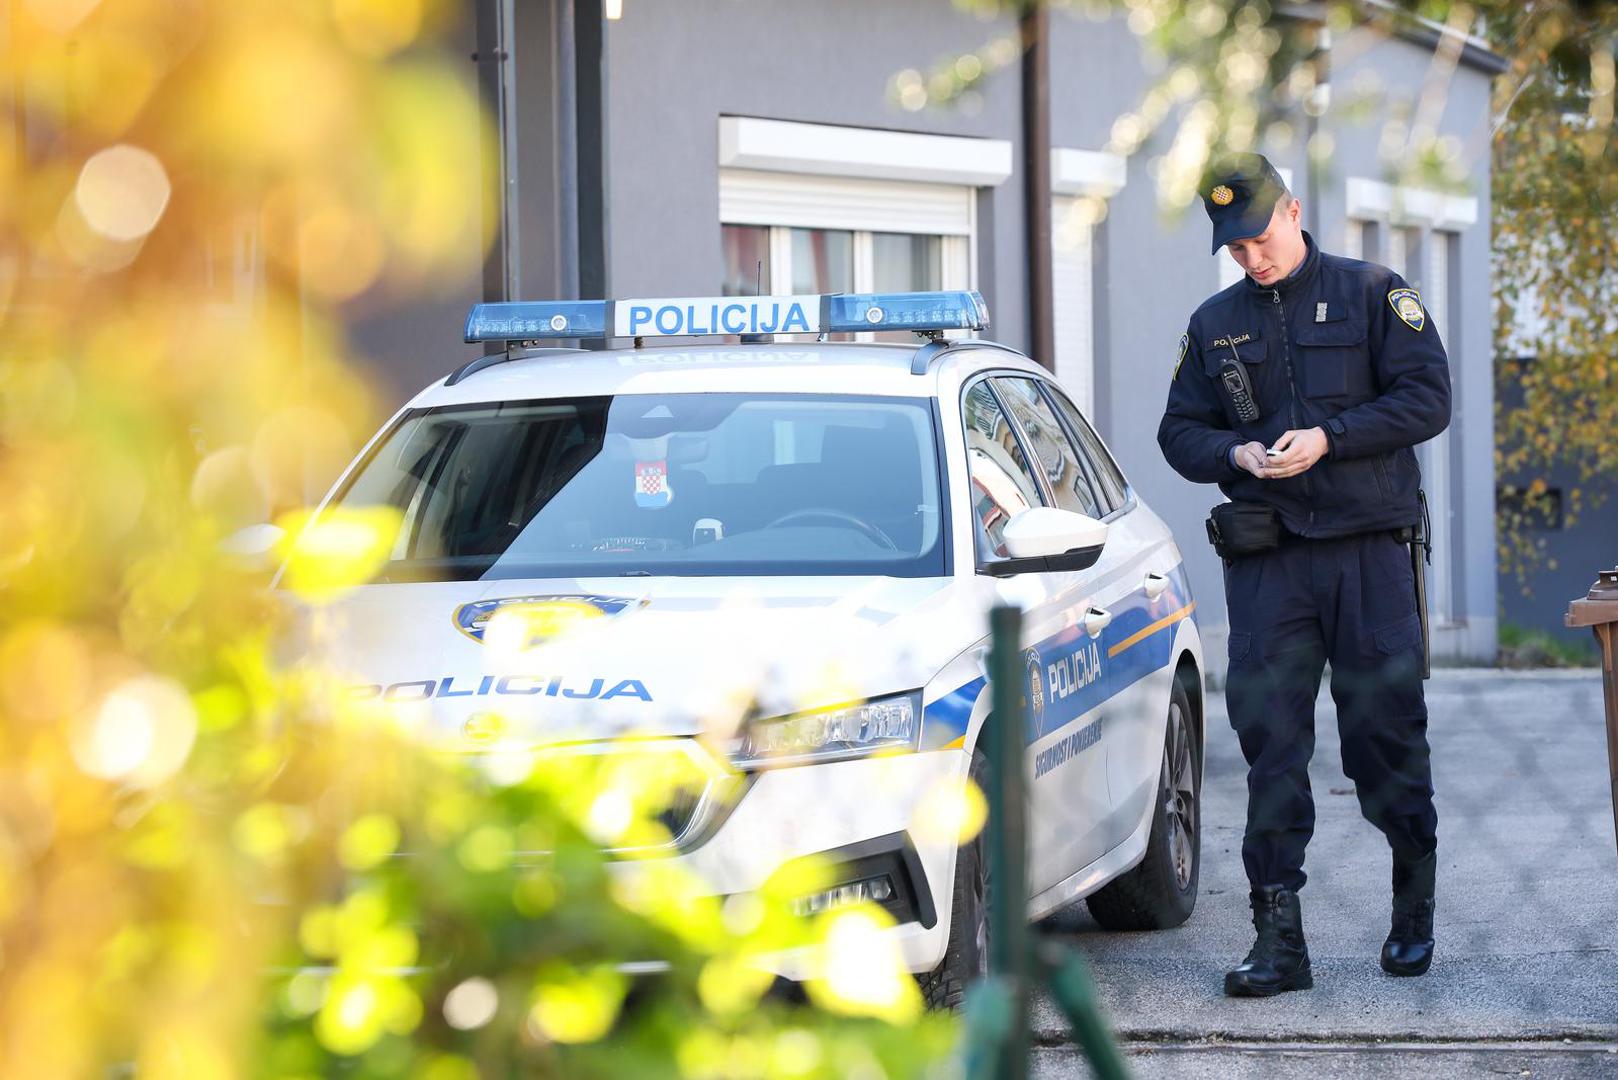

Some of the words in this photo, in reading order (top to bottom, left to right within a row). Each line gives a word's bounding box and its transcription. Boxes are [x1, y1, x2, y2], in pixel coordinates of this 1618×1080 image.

[629, 302, 810, 335] POLICIJA
[1213, 333, 1250, 347] POCIJA
[473, 595, 637, 607] POLICIJA
[1047, 642, 1102, 704] POLICIJA
[1035, 738, 1068, 780] SIGURNOST
